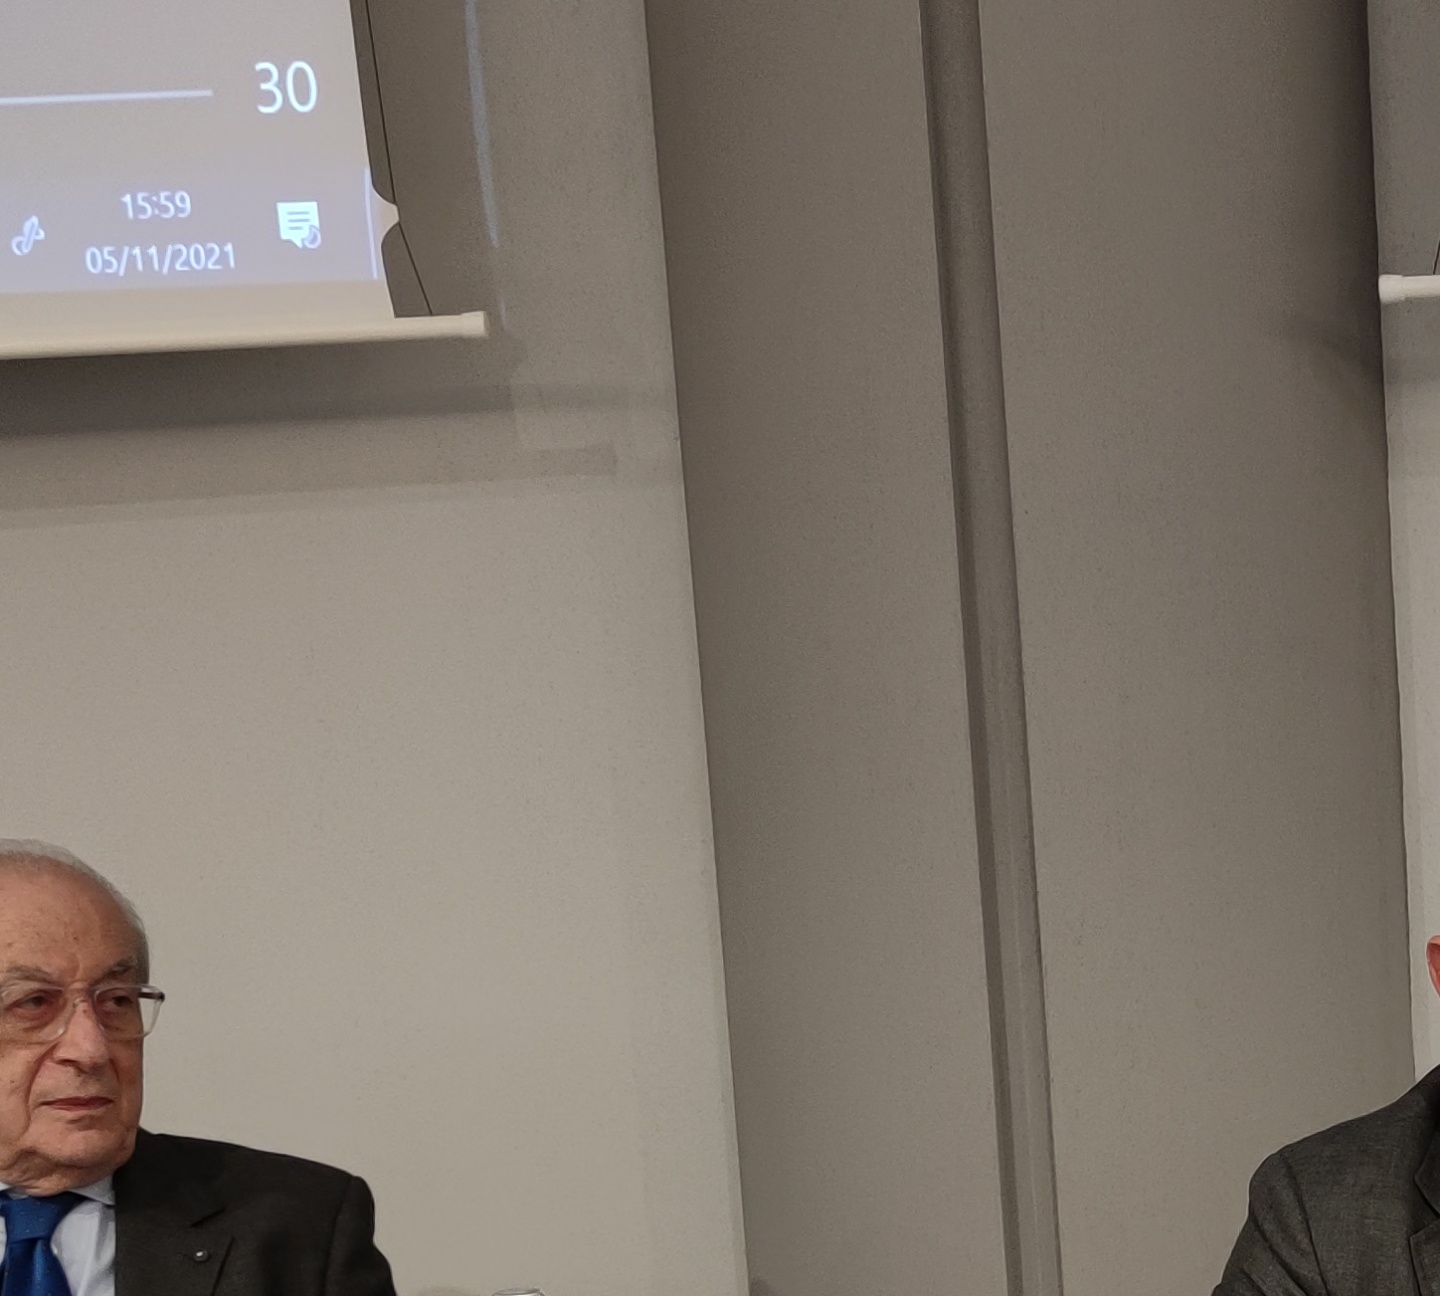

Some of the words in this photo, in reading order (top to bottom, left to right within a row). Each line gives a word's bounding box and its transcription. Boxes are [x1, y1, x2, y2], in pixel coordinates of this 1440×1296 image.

[255, 61, 318, 113] 30
[121, 190, 191, 219] 15:59
[85, 242, 236, 276] 05/11/2021
